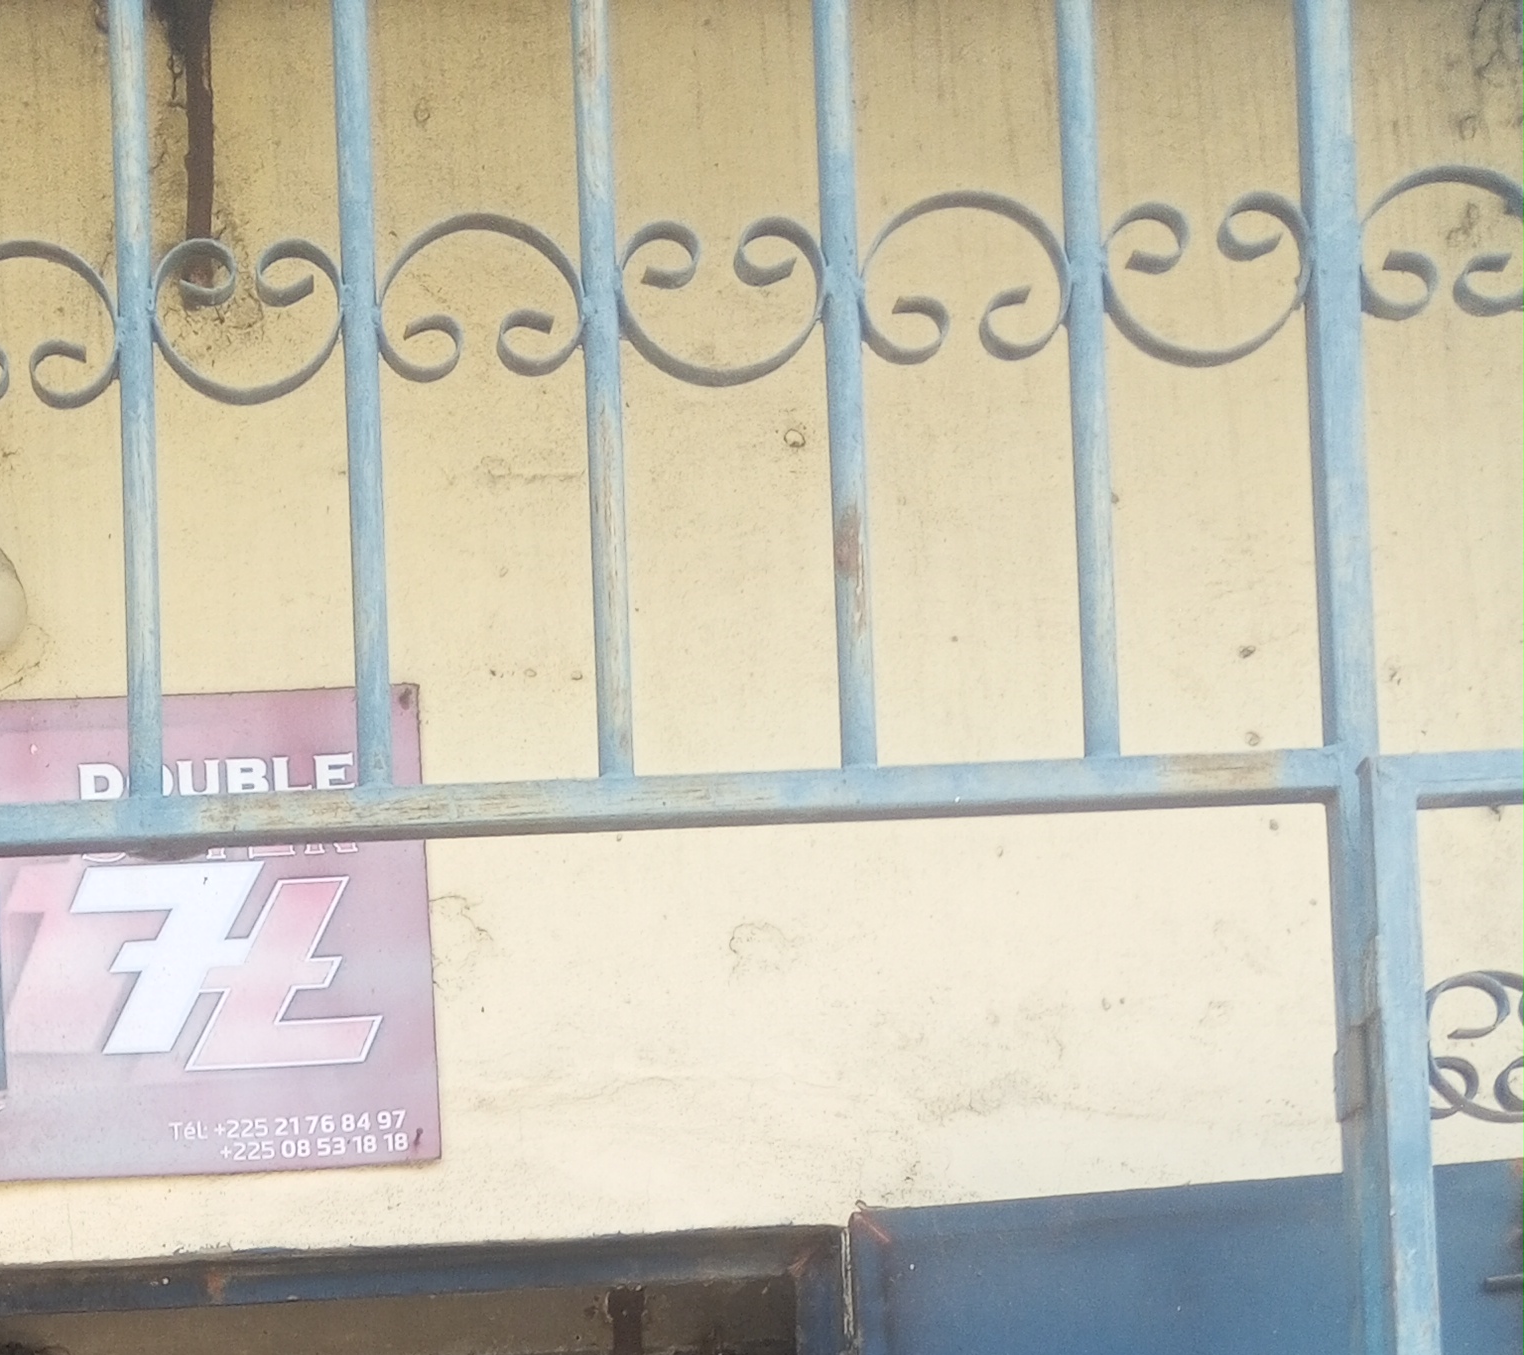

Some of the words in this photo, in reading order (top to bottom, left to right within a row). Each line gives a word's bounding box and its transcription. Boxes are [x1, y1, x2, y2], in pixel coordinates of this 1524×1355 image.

[78, 752, 356, 801] DUBLE
[214, 1118, 269, 1139] +225
[275, 1116, 300, 1136] 21
[305, 1114, 336, 1135] 76
[341, 1112, 371, 1132] 84
[377, 1109, 407, 1130] 97
[220, 1140, 276, 1161] +225
[281, 1138, 311, 1159] 08
[316, 1136, 346, 1157] 53
[352, 1134, 378, 1154] 18
[383, 1132, 408, 1152] 18
